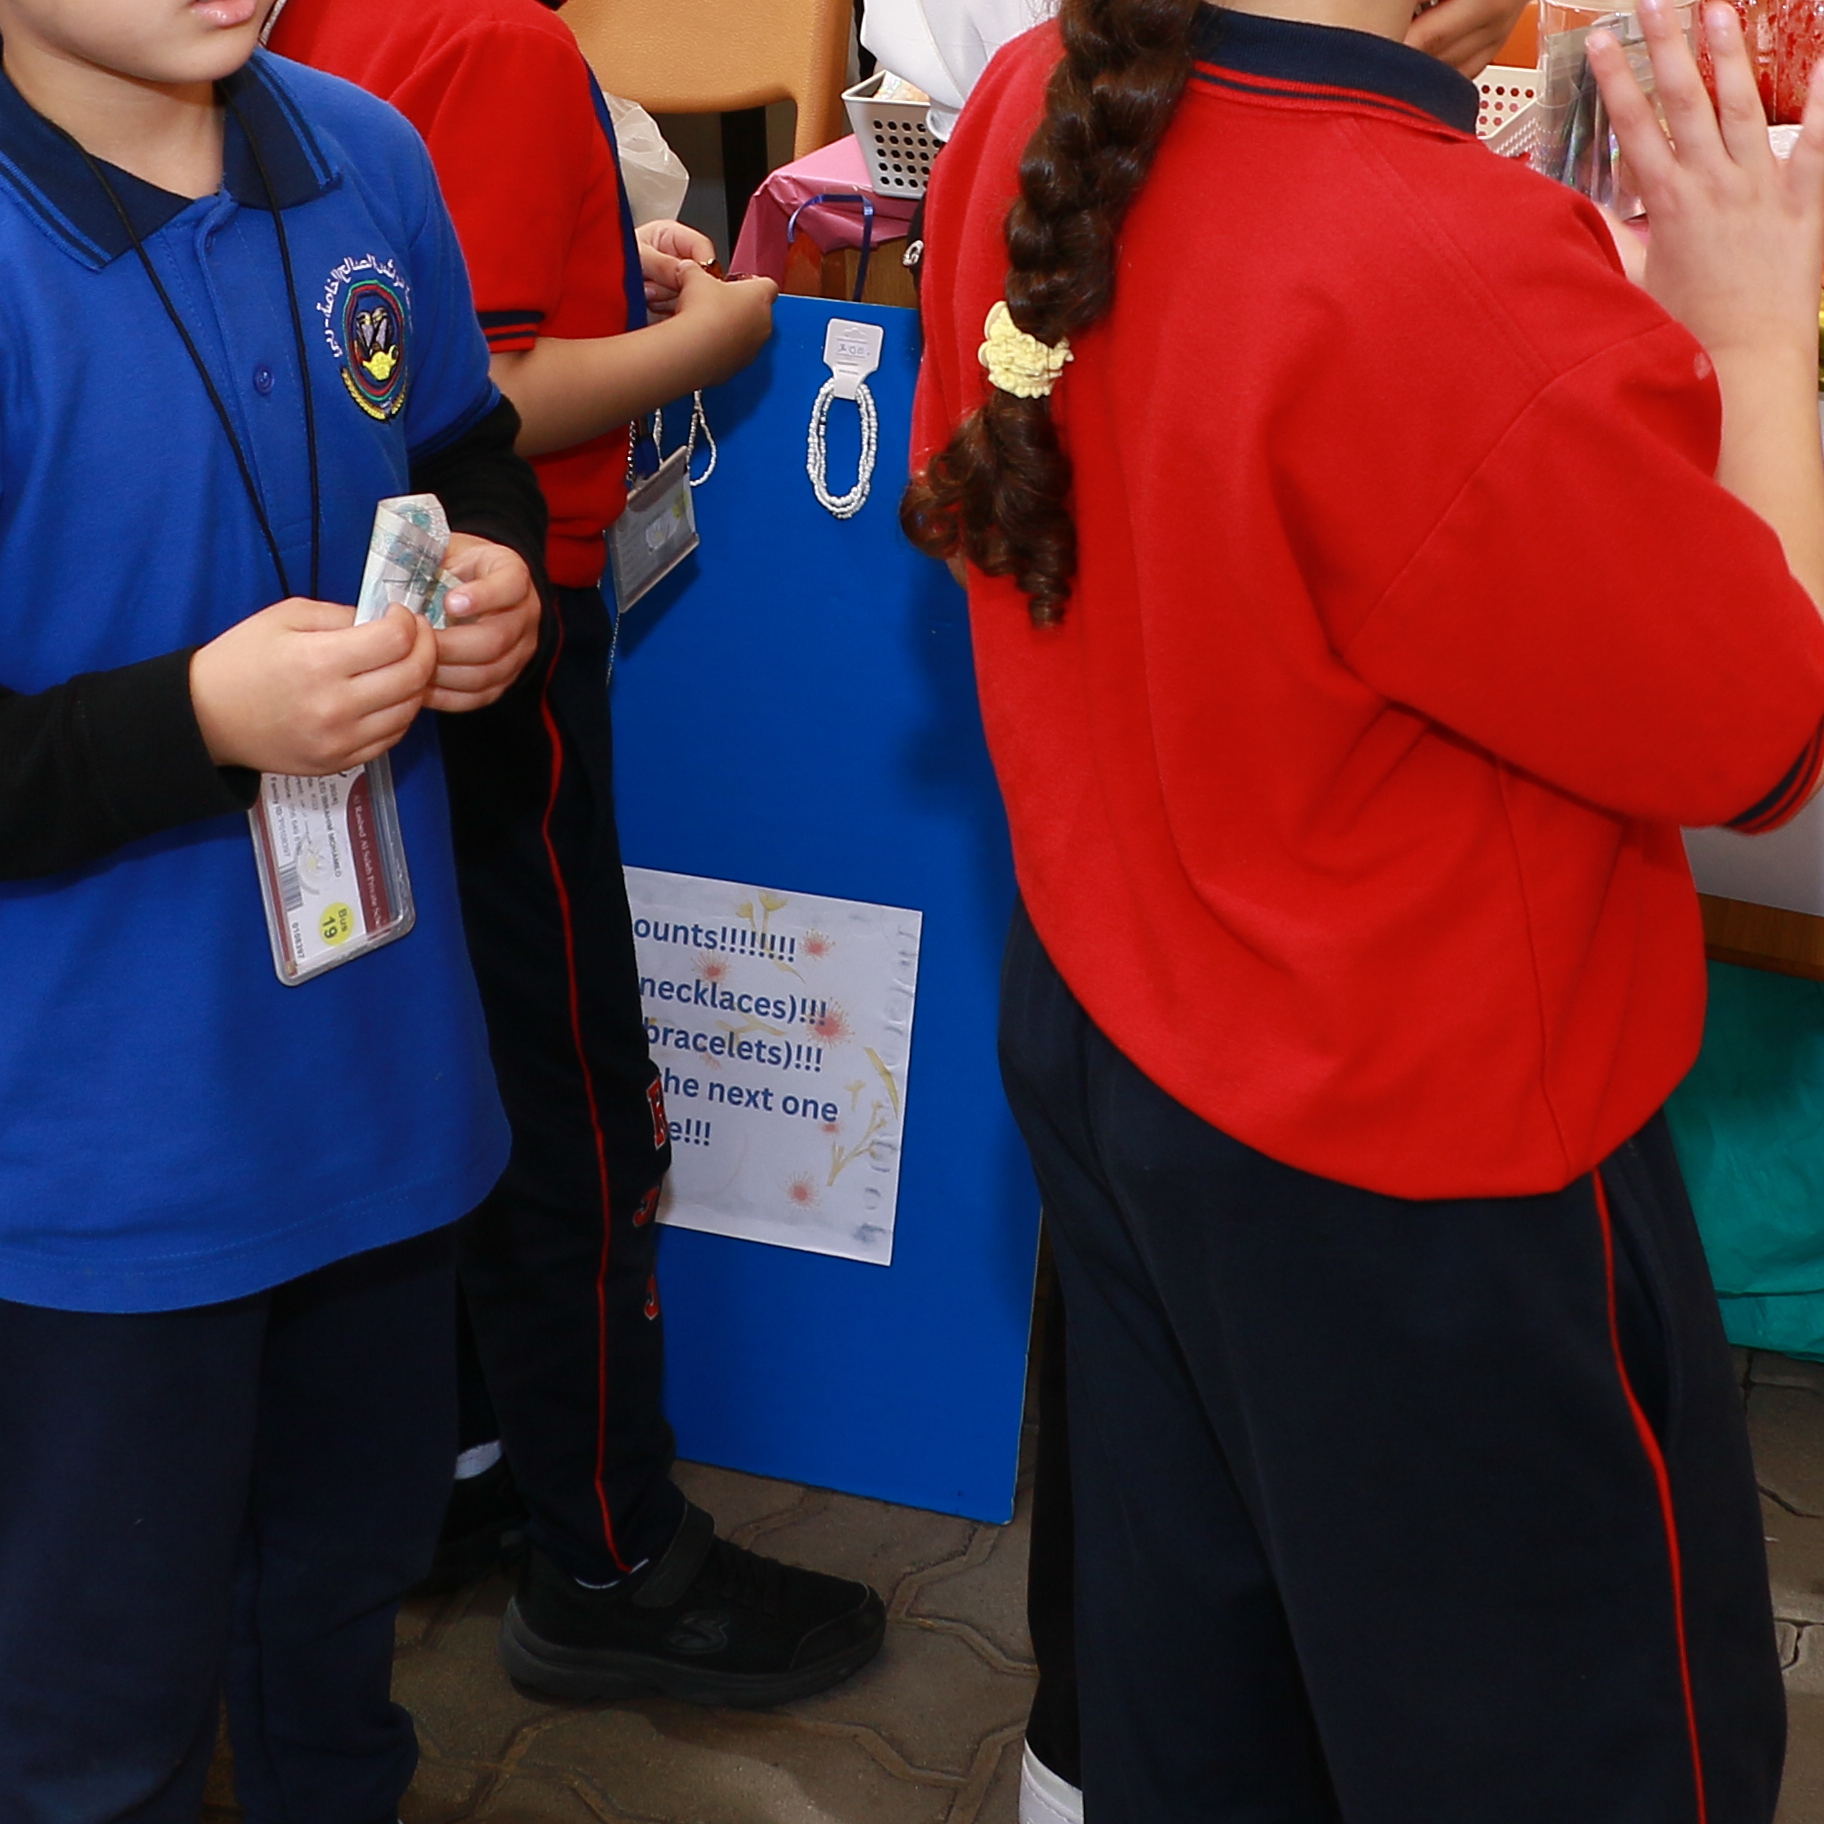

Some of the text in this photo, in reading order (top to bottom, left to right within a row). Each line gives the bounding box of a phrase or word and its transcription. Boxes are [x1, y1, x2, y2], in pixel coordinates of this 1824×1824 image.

[322, 915, 338, 940] 19
[337, 908, 349, 932] Bus
[633, 918, 796, 963] ounts!!!!!!!!
[663, 1067, 839, 1123] he next one
[668, 1118, 712, 1147] e!!!
